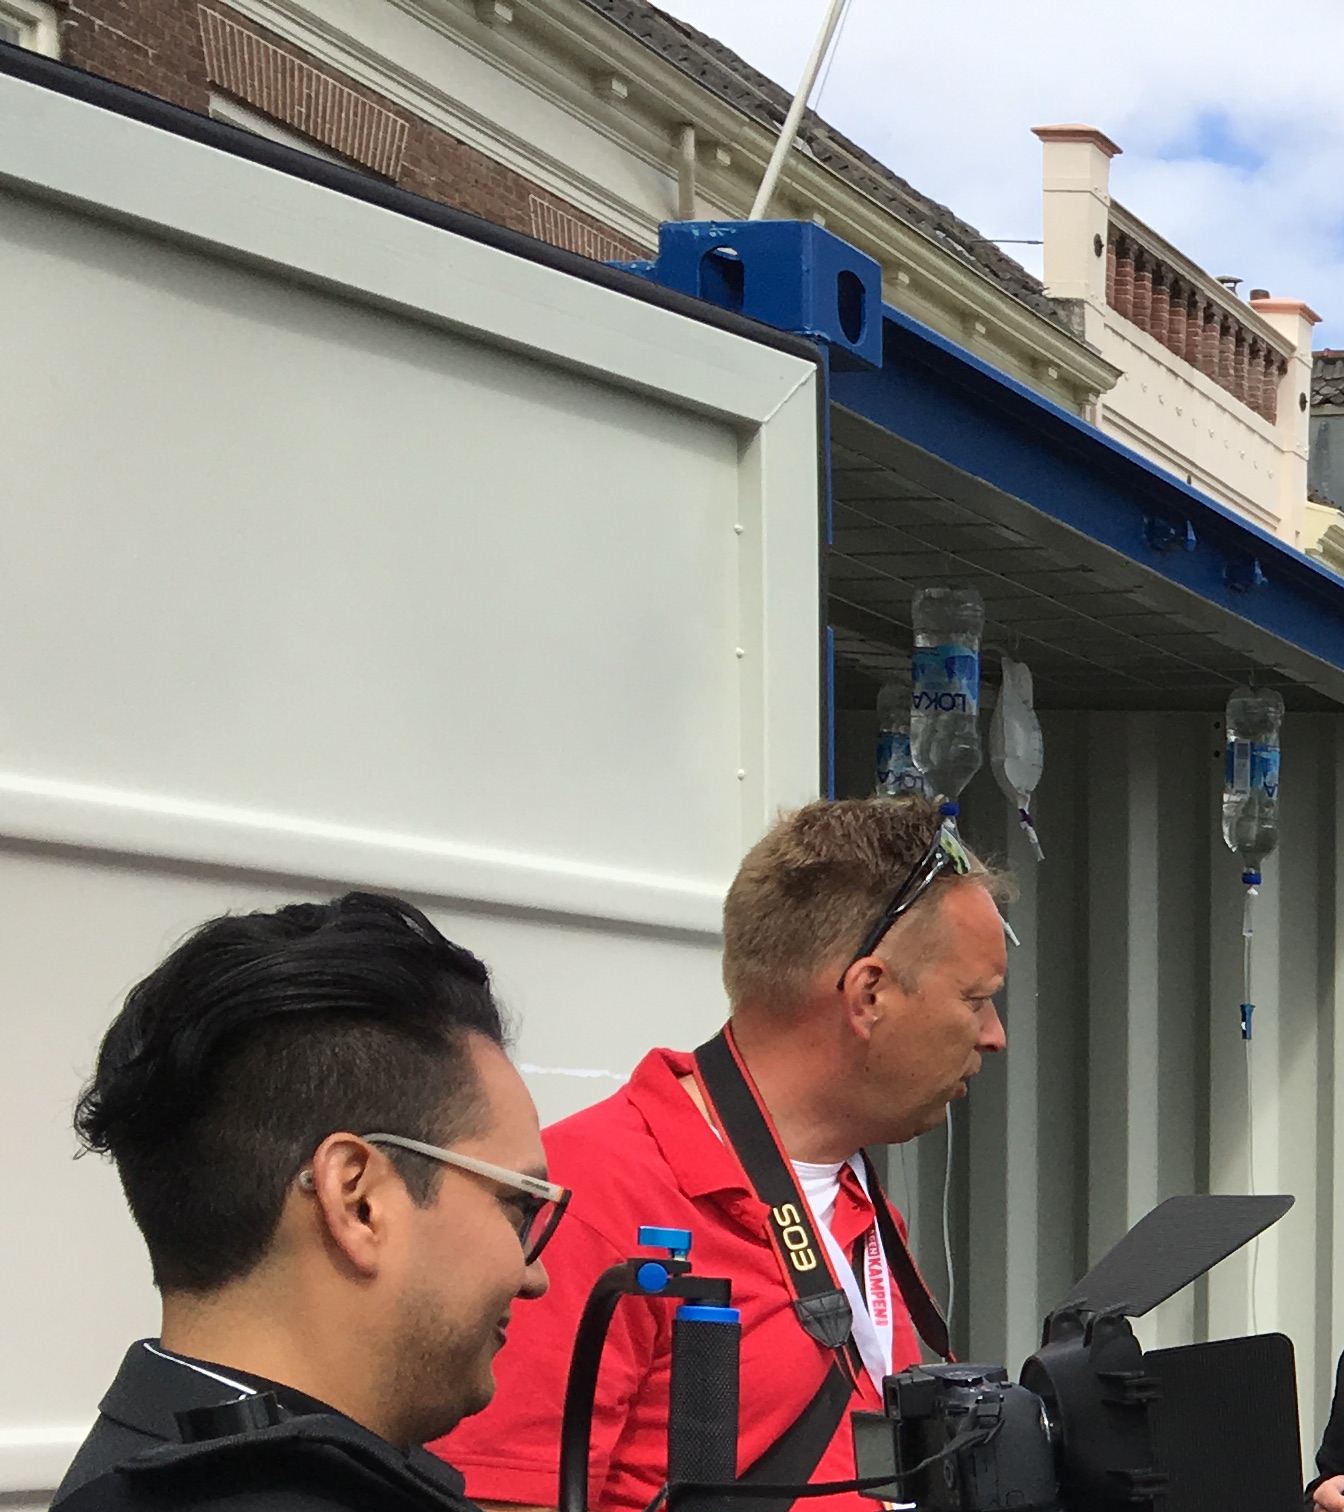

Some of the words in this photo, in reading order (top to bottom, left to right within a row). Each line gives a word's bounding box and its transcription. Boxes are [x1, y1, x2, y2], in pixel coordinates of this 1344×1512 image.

[912, 691, 967, 713] LOKA
[772, 1203, 818, 1272] EOS
[867, 1257, 888, 1320] KAMPEN
